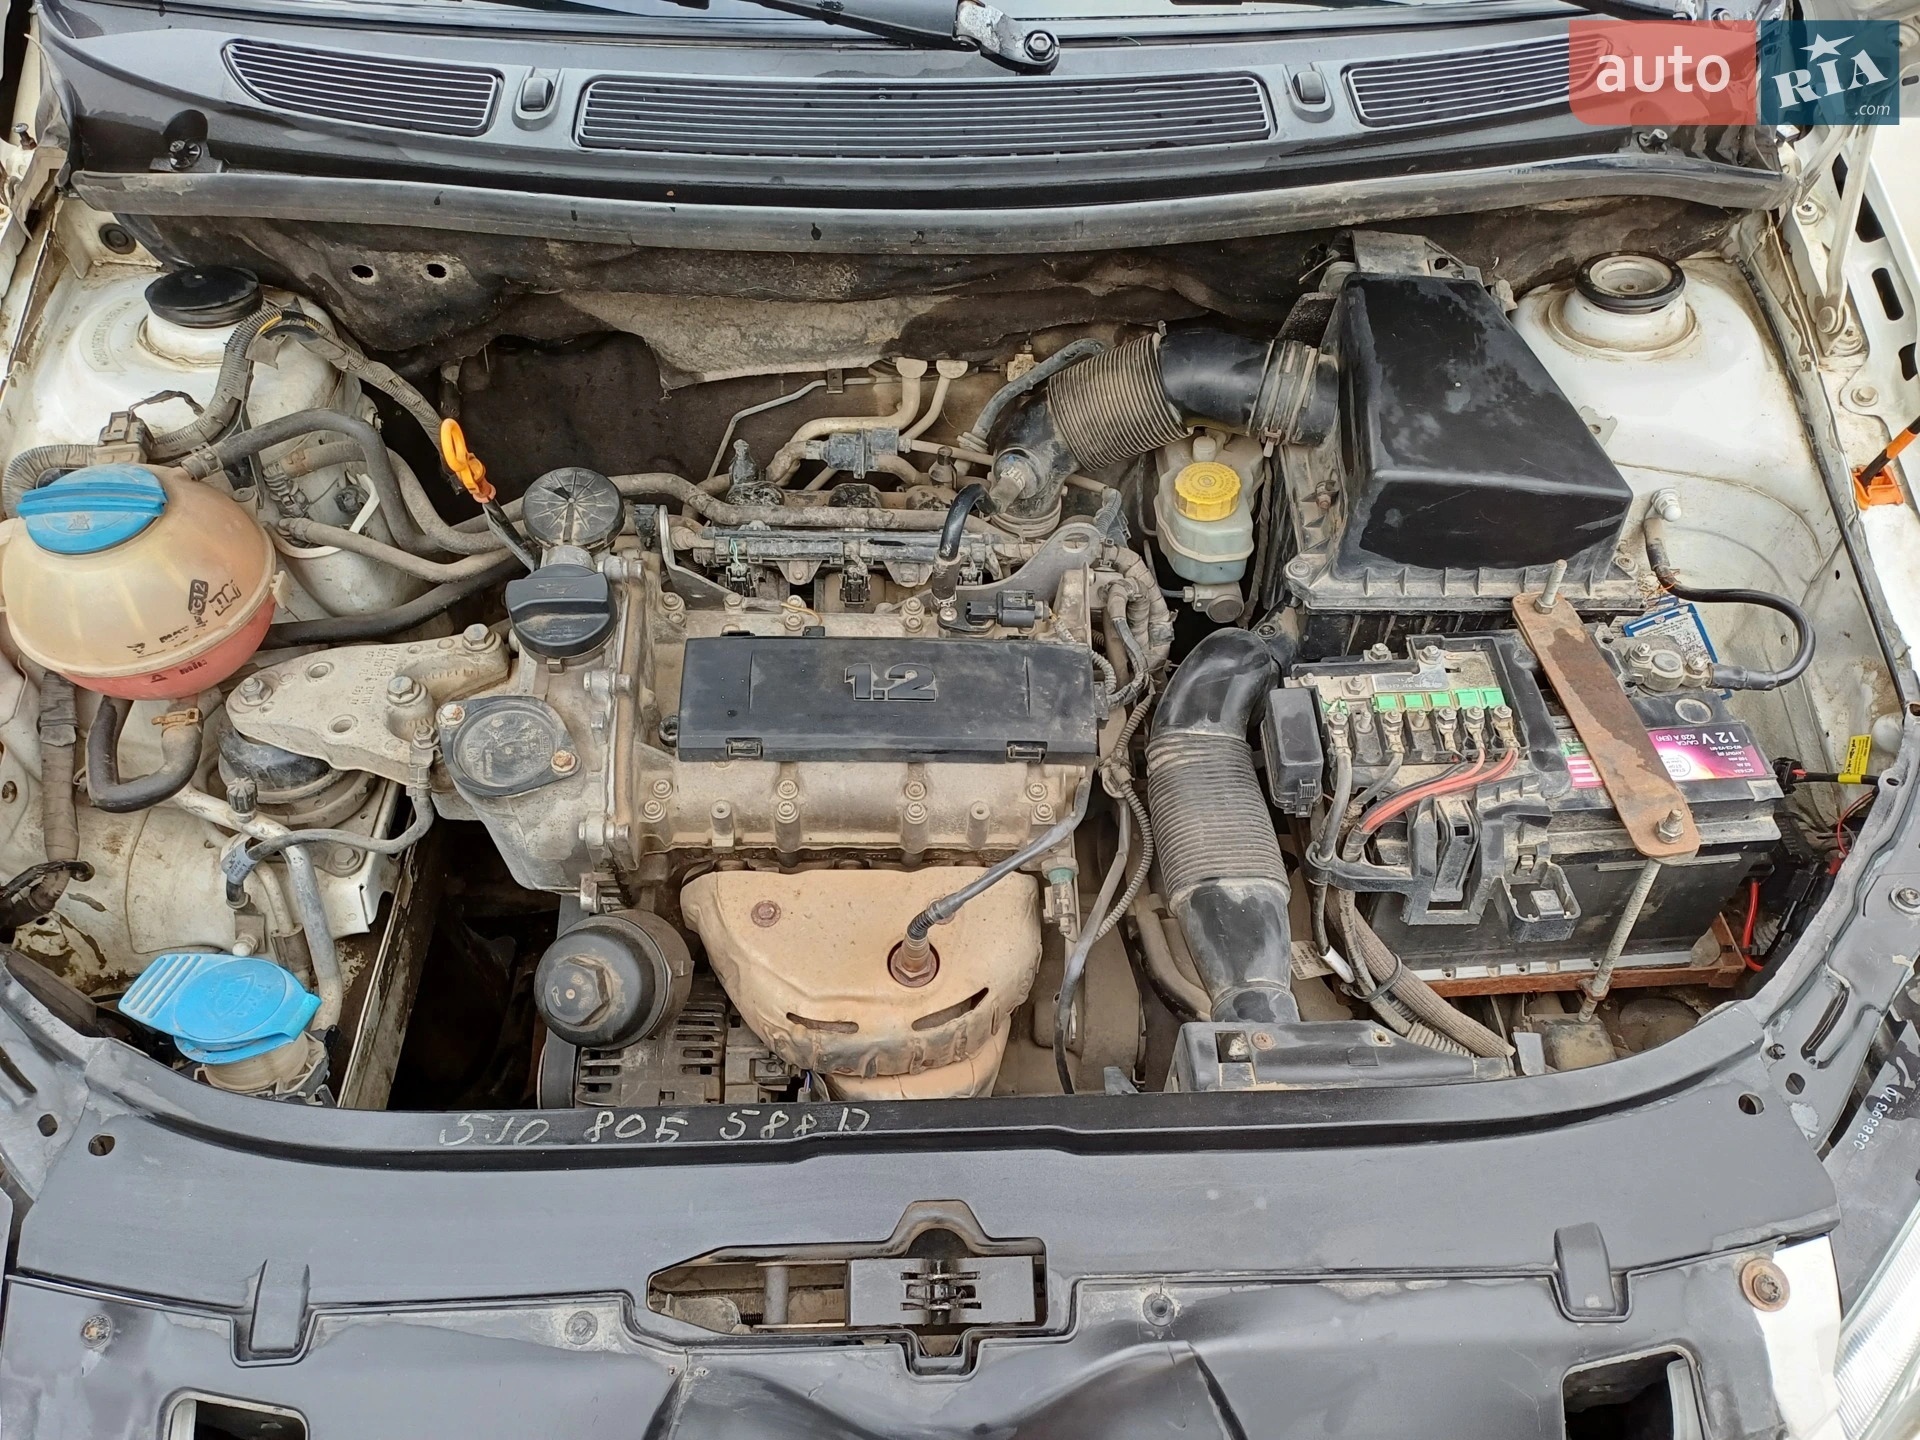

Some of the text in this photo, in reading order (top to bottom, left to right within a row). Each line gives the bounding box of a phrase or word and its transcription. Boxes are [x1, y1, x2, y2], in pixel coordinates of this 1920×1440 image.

[844, 662, 938, 702] 1.2
[1702, 731, 1739, 744] 12 V
